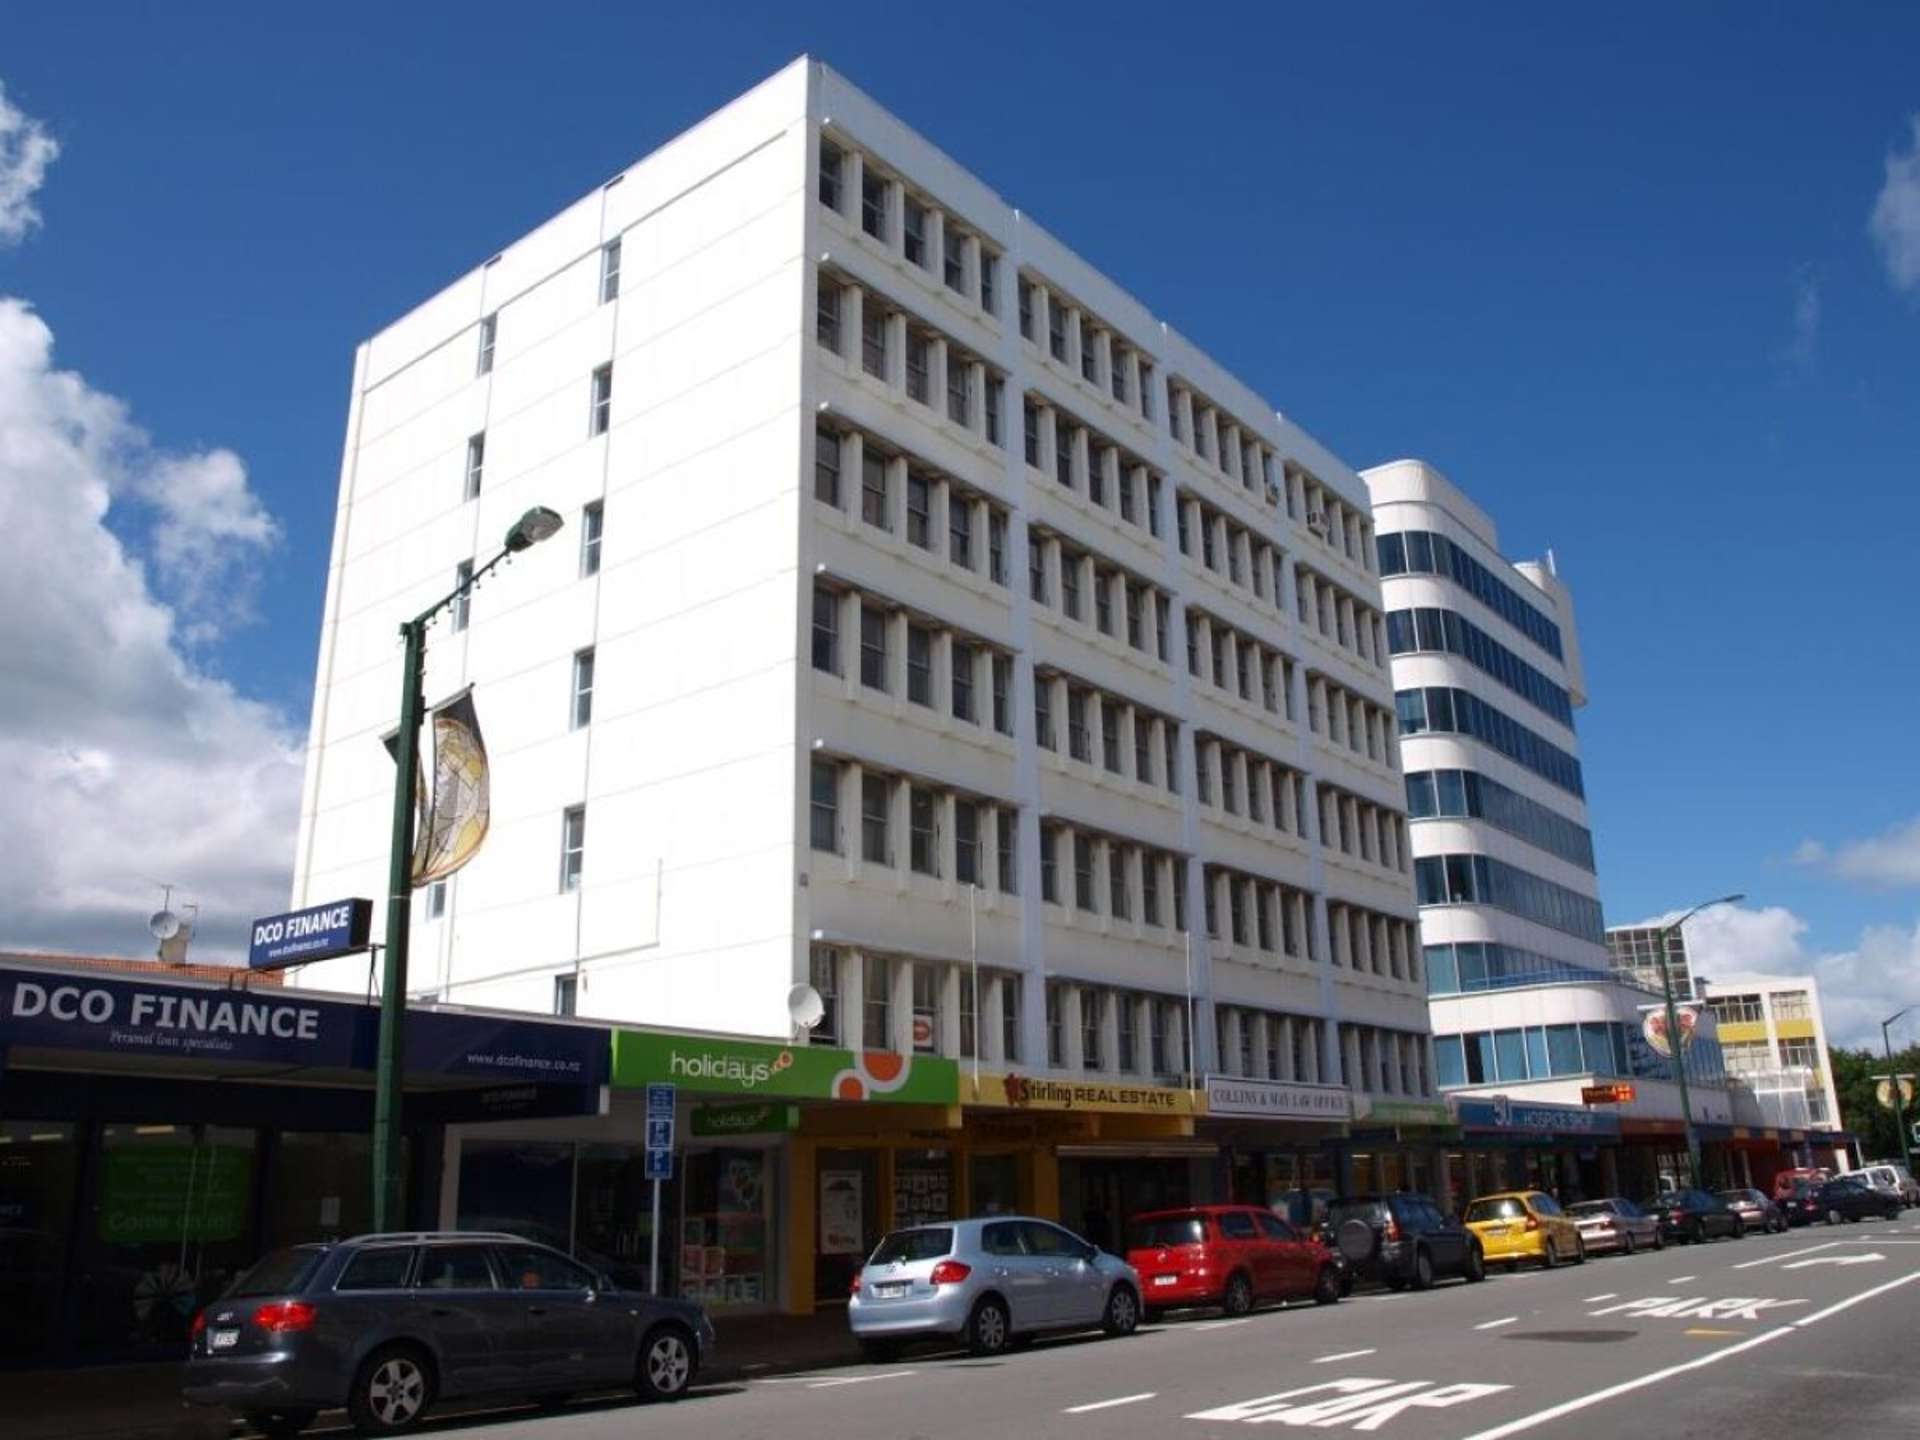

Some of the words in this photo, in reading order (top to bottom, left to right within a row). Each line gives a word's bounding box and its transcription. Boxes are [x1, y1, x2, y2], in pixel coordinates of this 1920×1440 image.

[255, 923, 283, 946] DCO
[285, 905, 350, 939] FINANCE
[12, 982, 116, 1024] DCO
[130, 992, 320, 1040] FINANCE
[671, 1050, 770, 1088] holidays
[1021, 1078, 1072, 1108] Stirling
[1588, 1297, 1810, 1319] PARK
[1181, 1377, 1516, 1430] CAR
